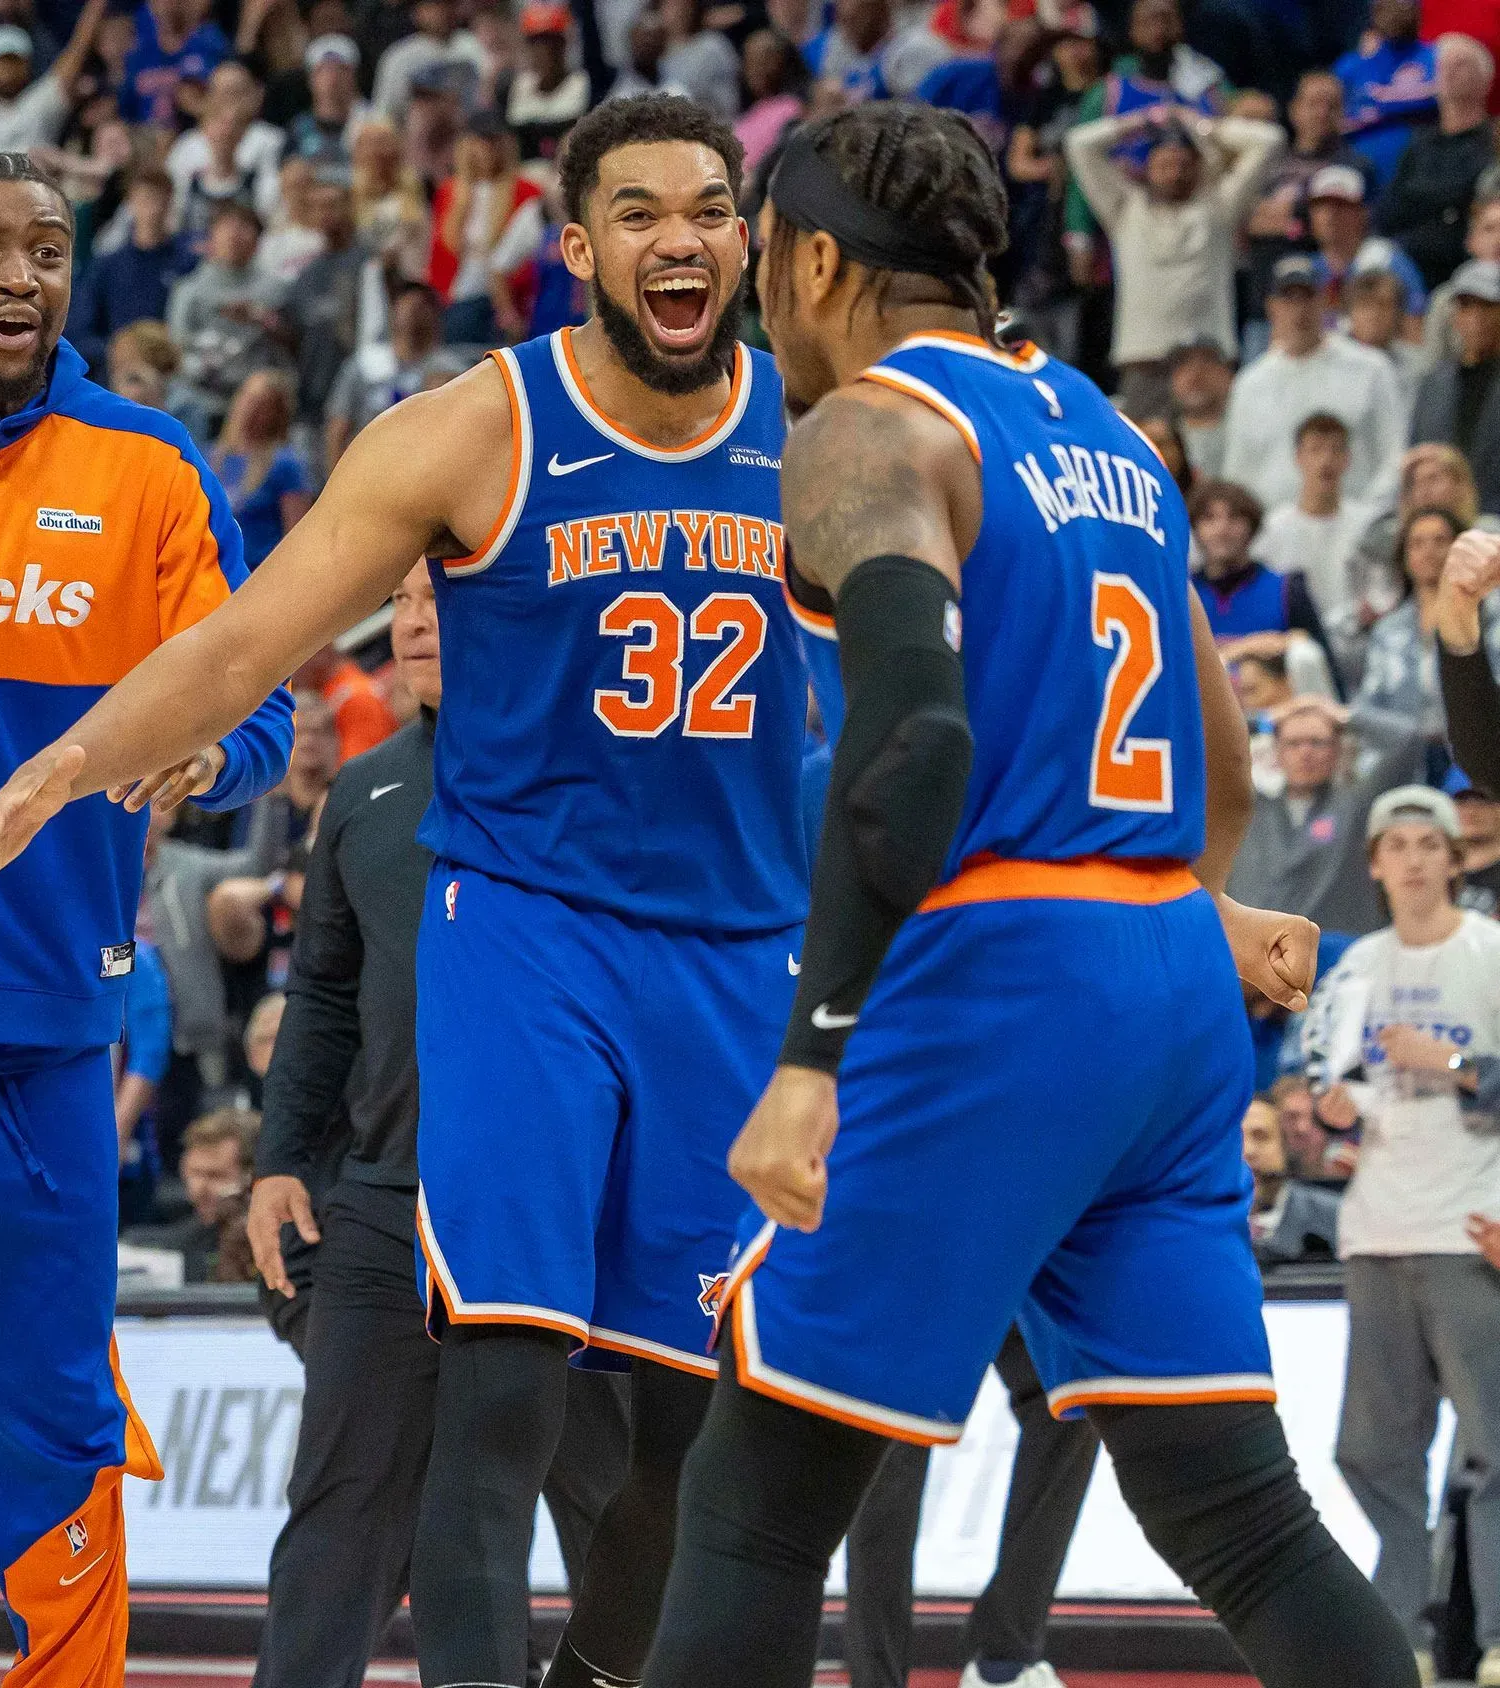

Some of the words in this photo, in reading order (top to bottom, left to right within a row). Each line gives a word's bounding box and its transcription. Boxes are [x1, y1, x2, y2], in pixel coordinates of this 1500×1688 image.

[729, 453, 755, 465] abu
[1014, 443, 1165, 547] McBRIDE
[39, 509, 73, 517] experience
[39, 516, 63, 529] abu
[65, 517, 101, 531] dhabi
[546, 511, 671, 588] NEW
[593, 591, 768, 739] 32
[1088, 570, 1173, 813] 2
